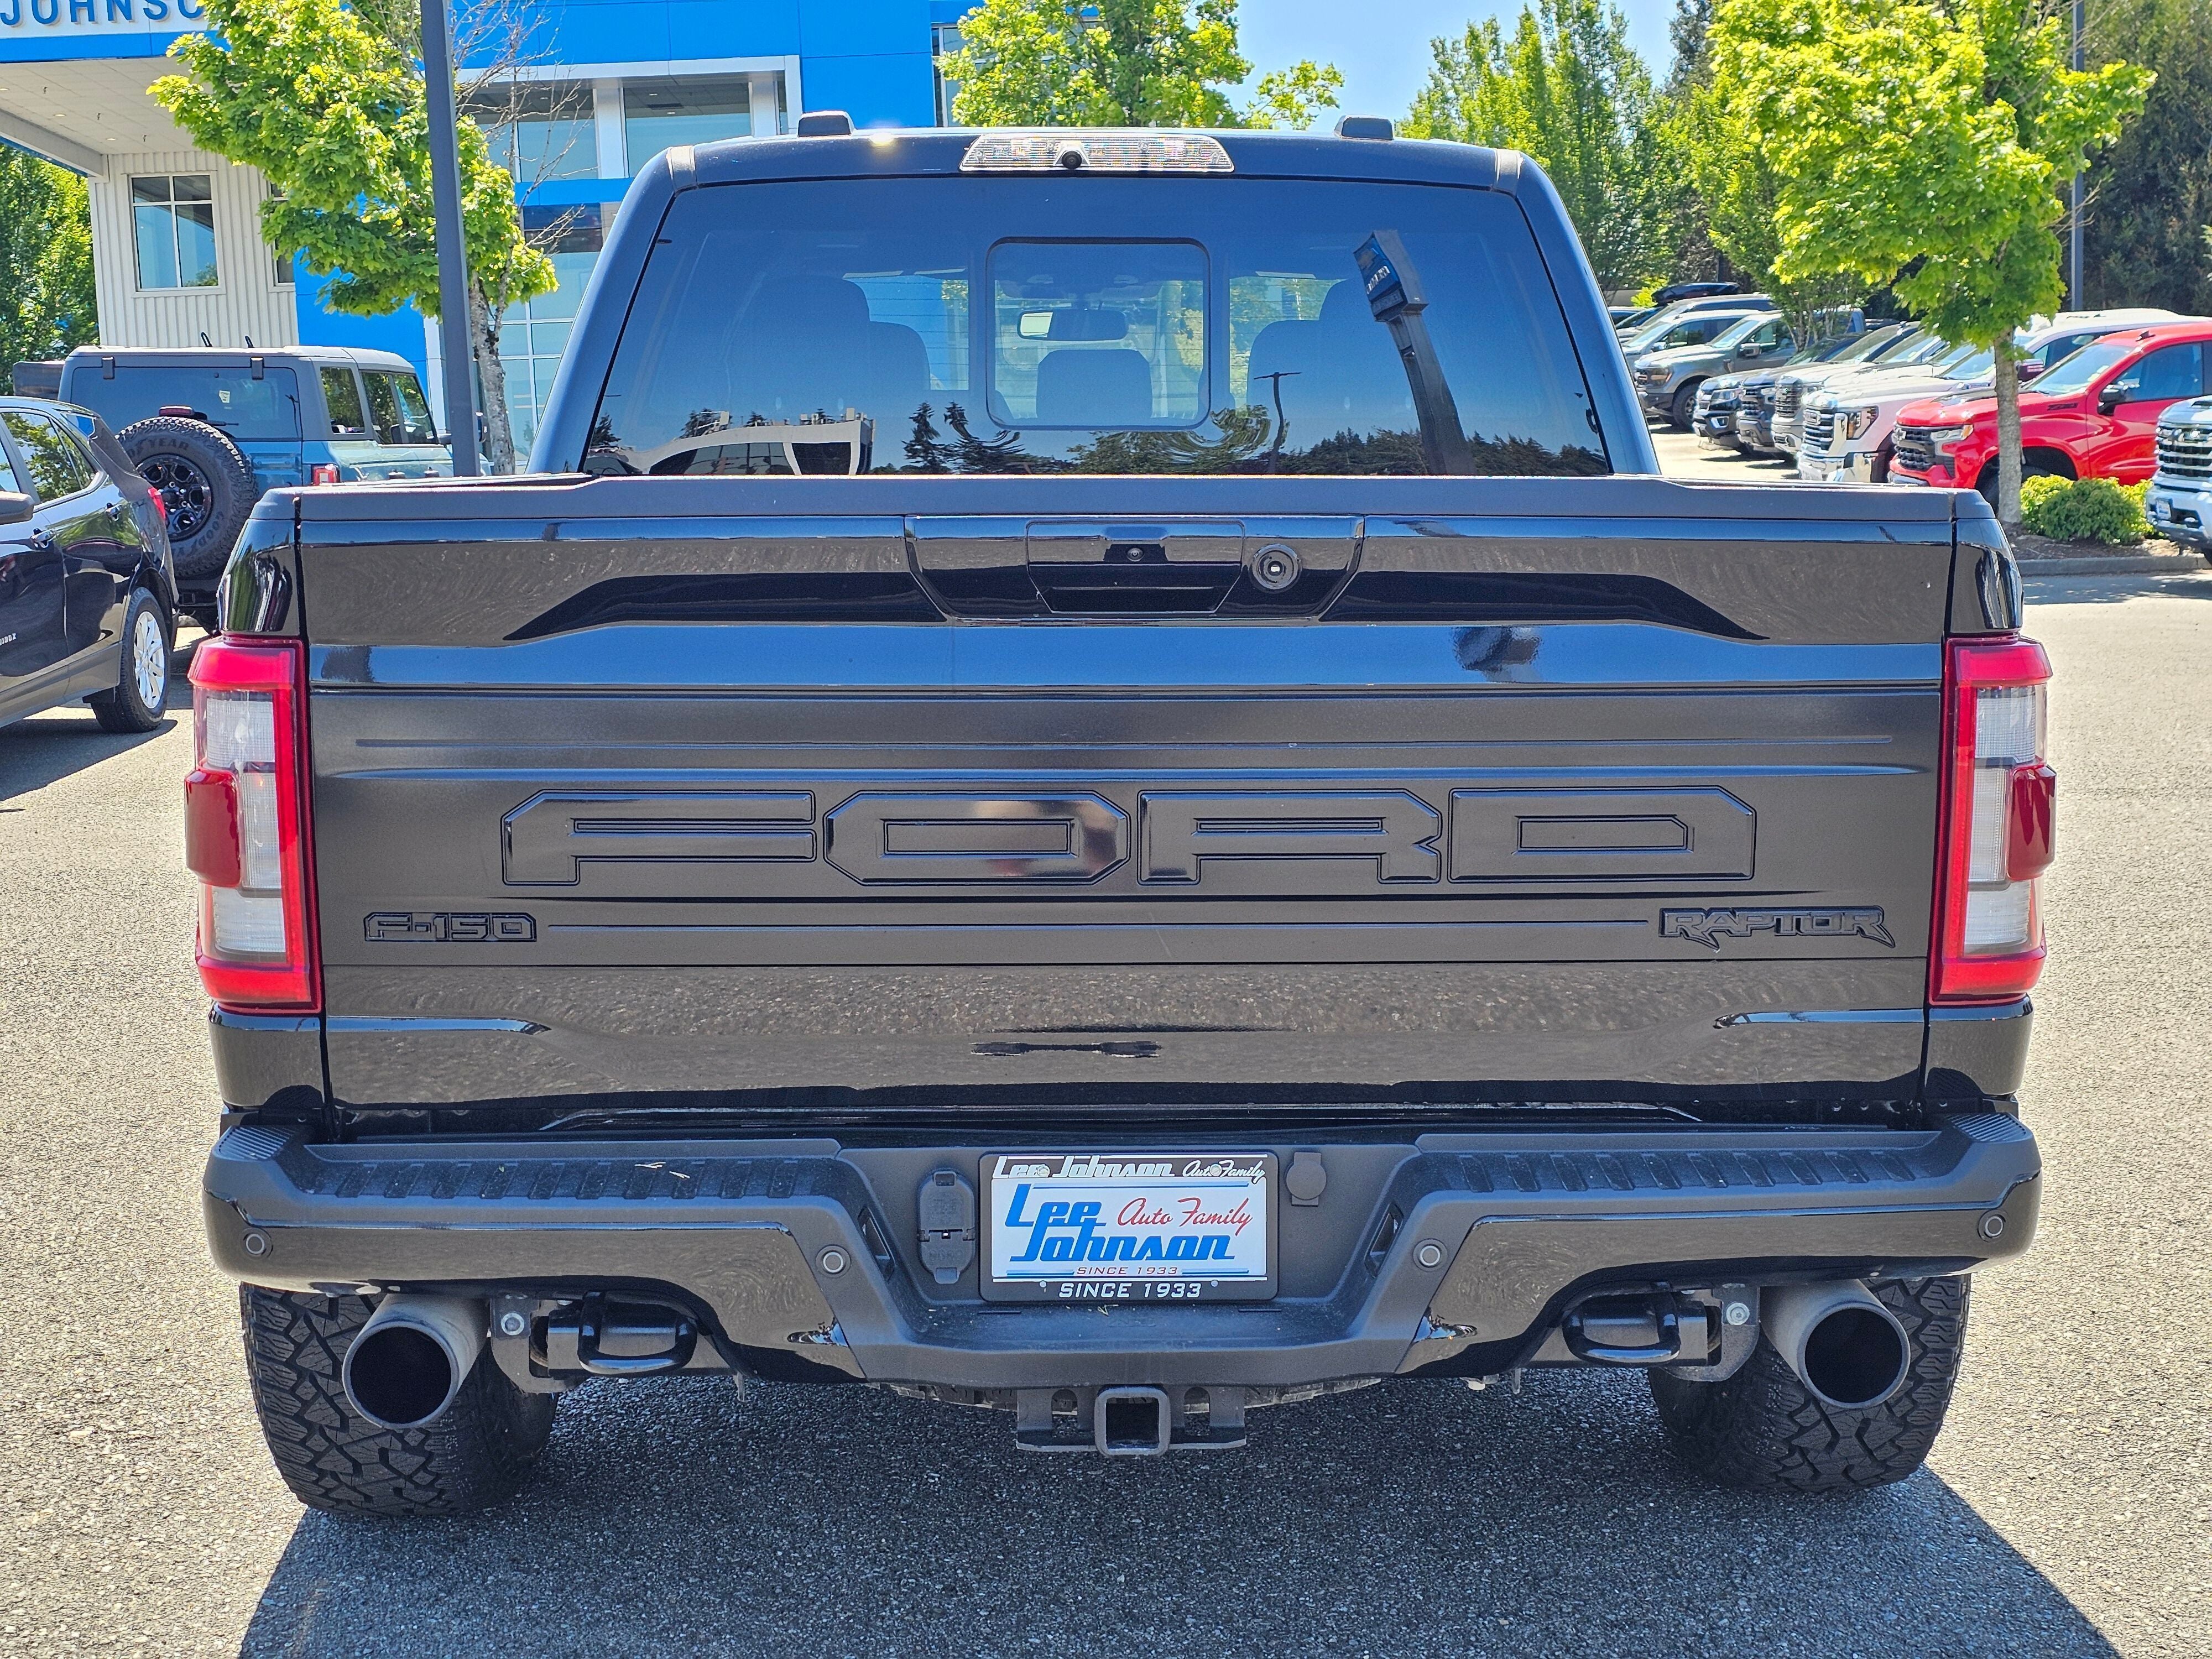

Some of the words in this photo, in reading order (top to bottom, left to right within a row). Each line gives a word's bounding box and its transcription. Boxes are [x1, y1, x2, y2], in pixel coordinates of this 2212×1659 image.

[502, 788, 1756, 886] FORD
[364, 912, 537, 942] F-150
[1658, 905, 1896, 952] RAPTOR
[1052, 1155, 1175, 1178] Johnson
[1182, 1159, 1222, 1177] Aut
[1217, 1159, 1266, 1184] Family
[1005, 1183, 1107, 1227] Lee
[1117, 1197, 1173, 1226] Auto
[1177, 1197, 1253, 1237] Family
[1009, 1217, 1235, 1262] Johnson
[1058, 1282, 1133, 1298] SINCE
[1143, 1282, 1202, 1298] 1933
